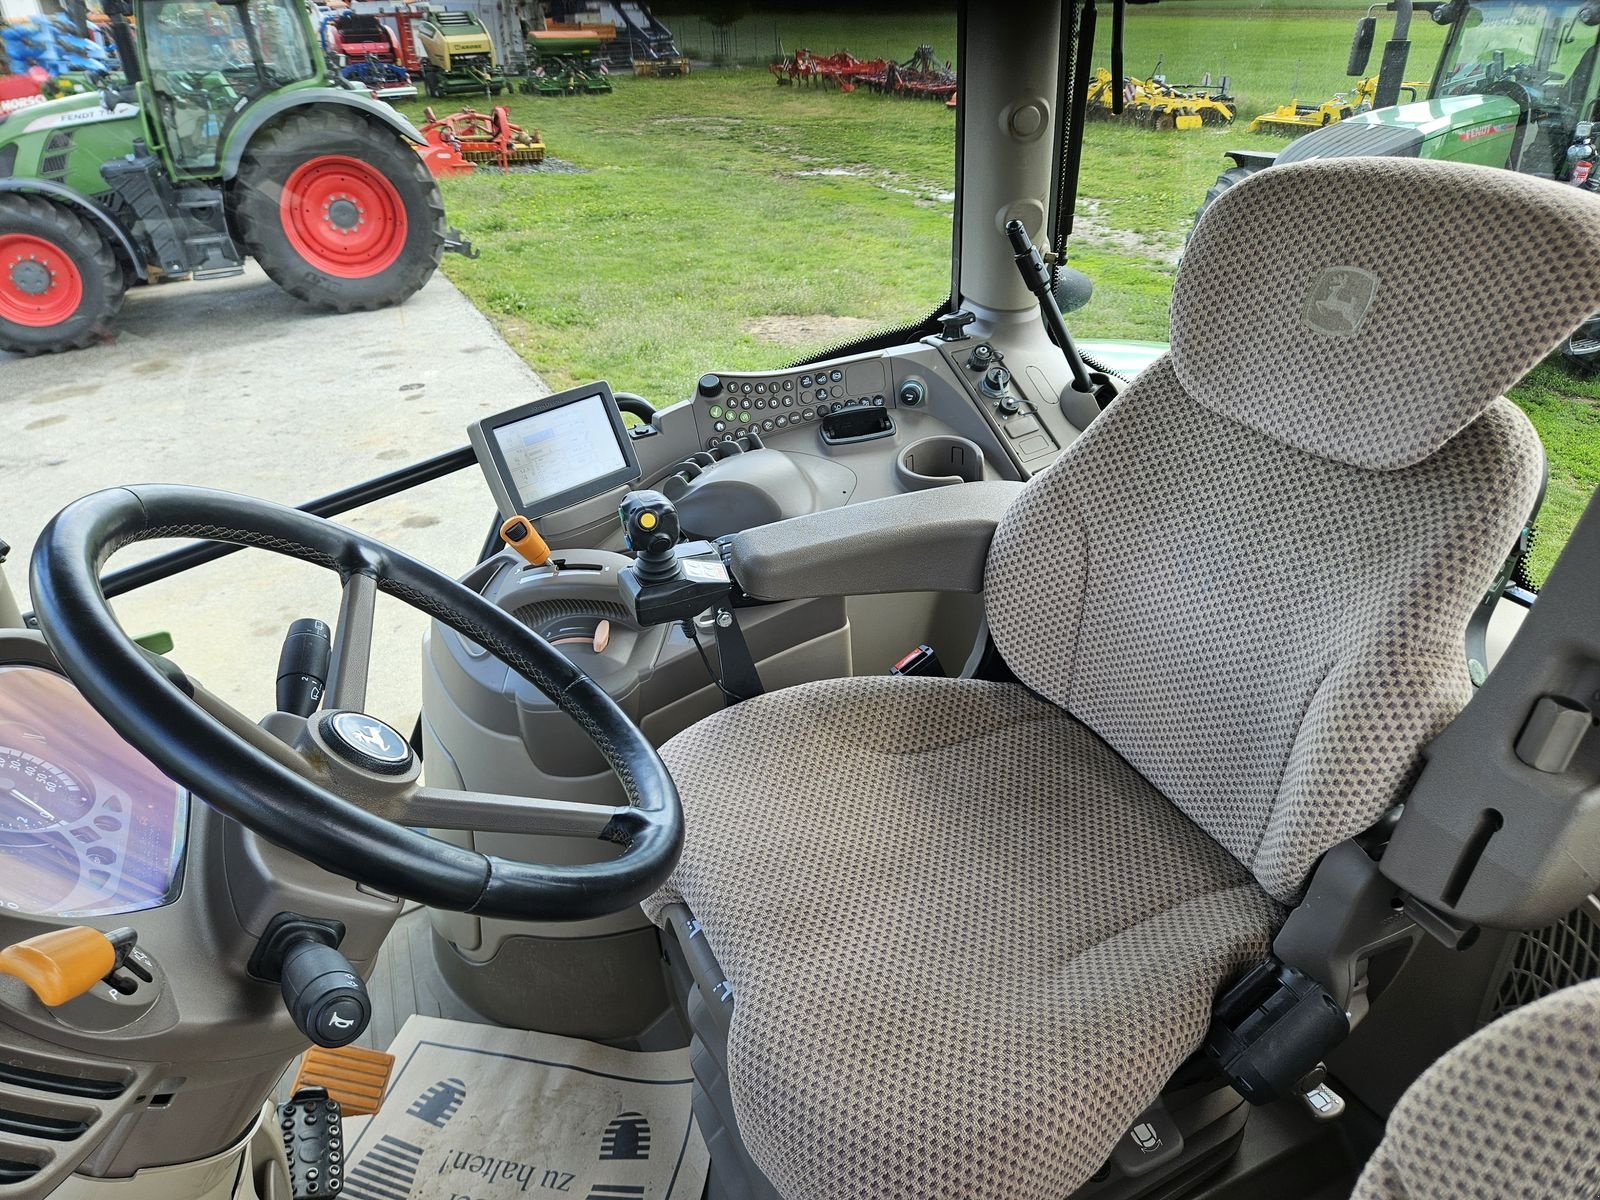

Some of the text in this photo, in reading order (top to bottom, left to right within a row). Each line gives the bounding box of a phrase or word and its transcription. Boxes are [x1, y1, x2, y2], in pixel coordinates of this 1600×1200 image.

[60, 112, 94, 121] FENDT
[1466, 124, 1491, 140] FENDT
[9, 760, 21, 772] 30
[24, 766, 36, 777] 40
[36, 773, 48, 784] 50
[45, 781, 57, 793] 60
[108, 988, 119, 1001] P
[437, 1149, 577, 1193] zu halten!
